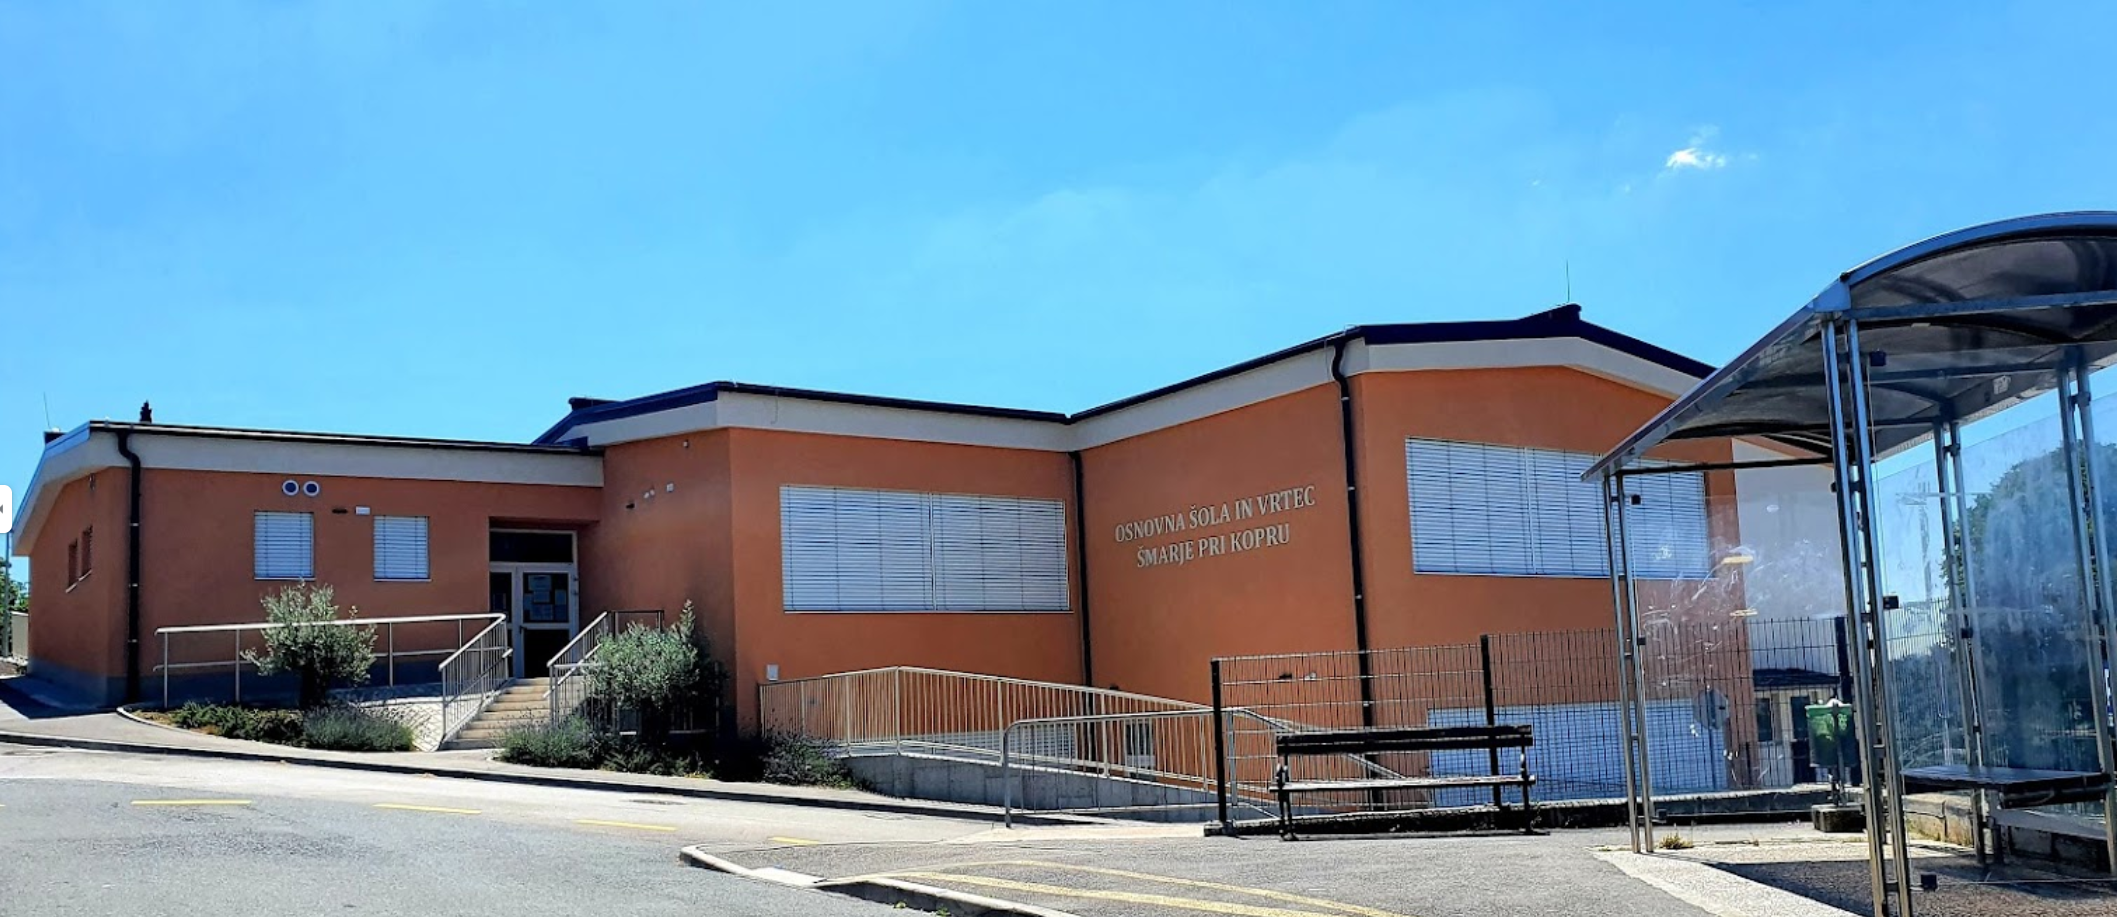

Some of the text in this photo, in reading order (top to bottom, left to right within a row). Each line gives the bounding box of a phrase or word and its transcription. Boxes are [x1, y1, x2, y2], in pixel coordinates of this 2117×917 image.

[1115, 485, 1316, 542] OSNOVNA ŠOLA IN VRTEC
[1137, 523, 1290, 568] ŠMARJE PRI KOPRU
